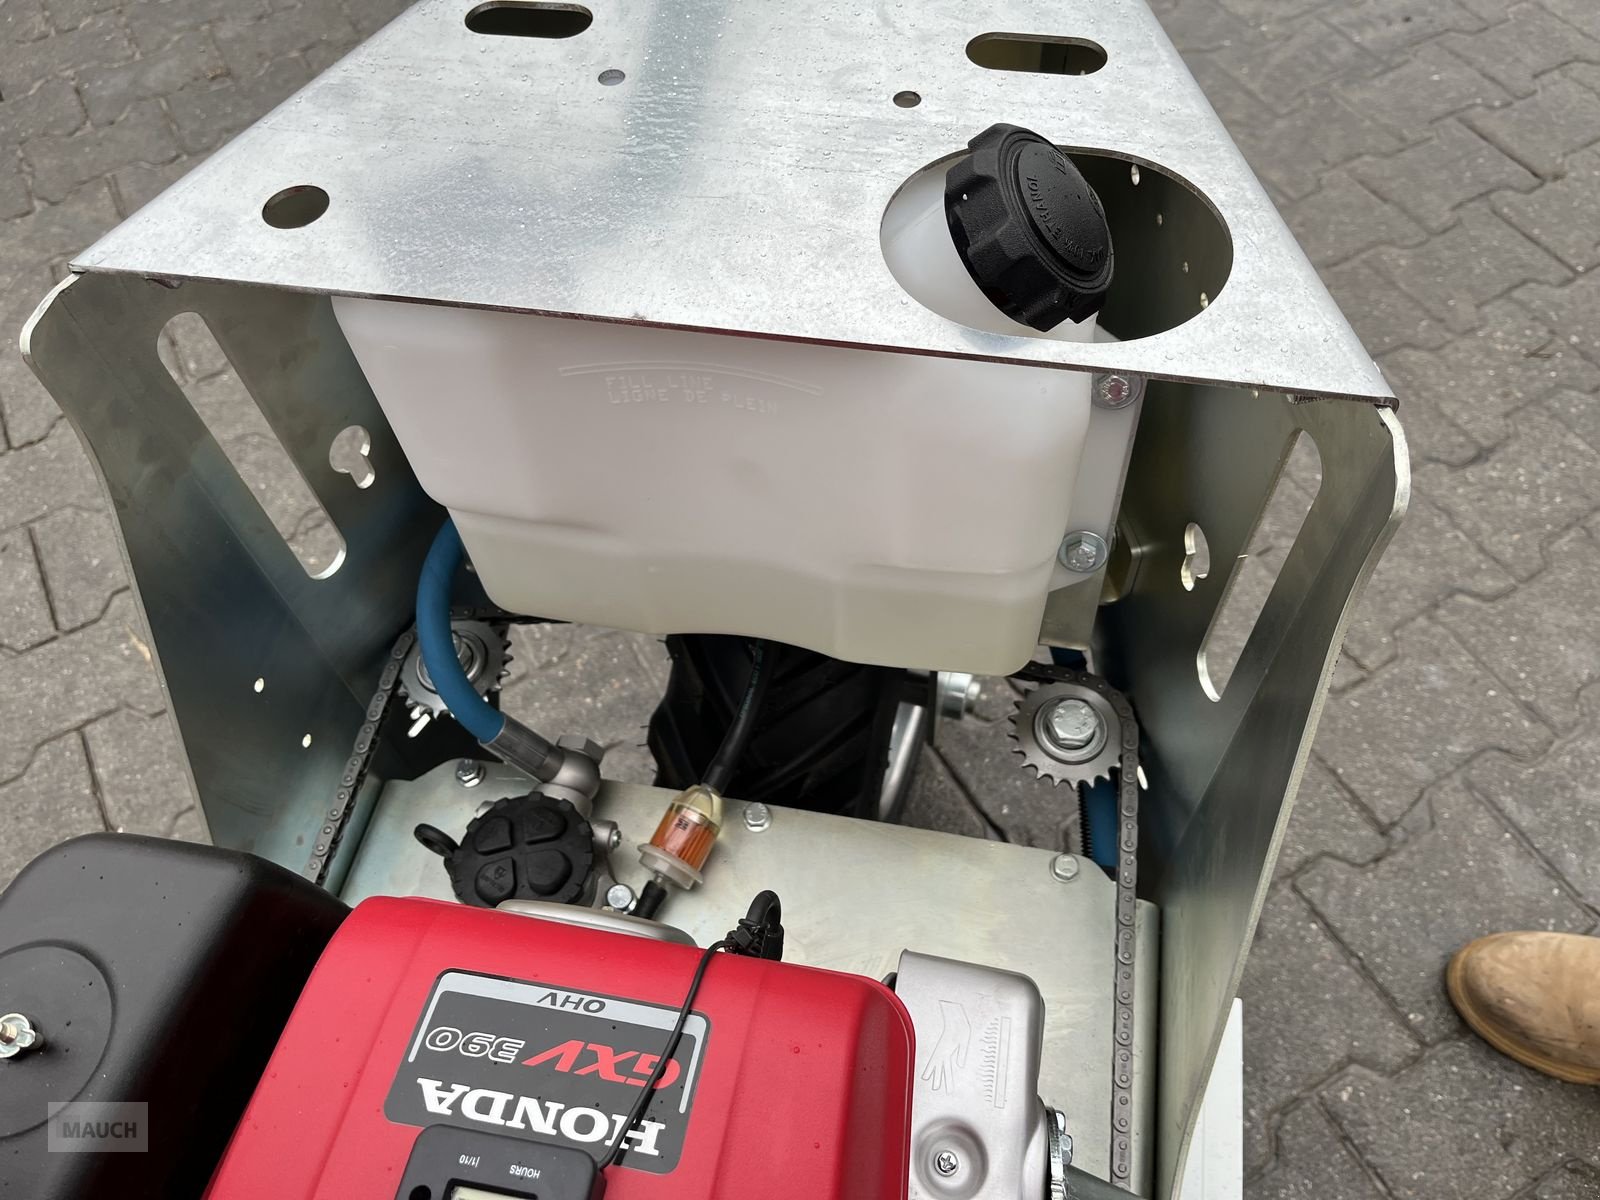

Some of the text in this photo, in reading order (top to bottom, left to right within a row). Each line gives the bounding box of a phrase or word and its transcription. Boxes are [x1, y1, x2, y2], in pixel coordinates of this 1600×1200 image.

[1026, 176, 1062, 241] ETHANOL
[605, 375, 713, 391] FILL LINE
[607, 388, 669, 404] LIGNE
[683, 388, 708, 404] DE
[536, 991, 606, 1014] OHV
[425, 1026, 682, 1090] GXV 390
[416, 1077, 666, 1157] HONDA
[509, 1163, 541, 1179] HOURS
